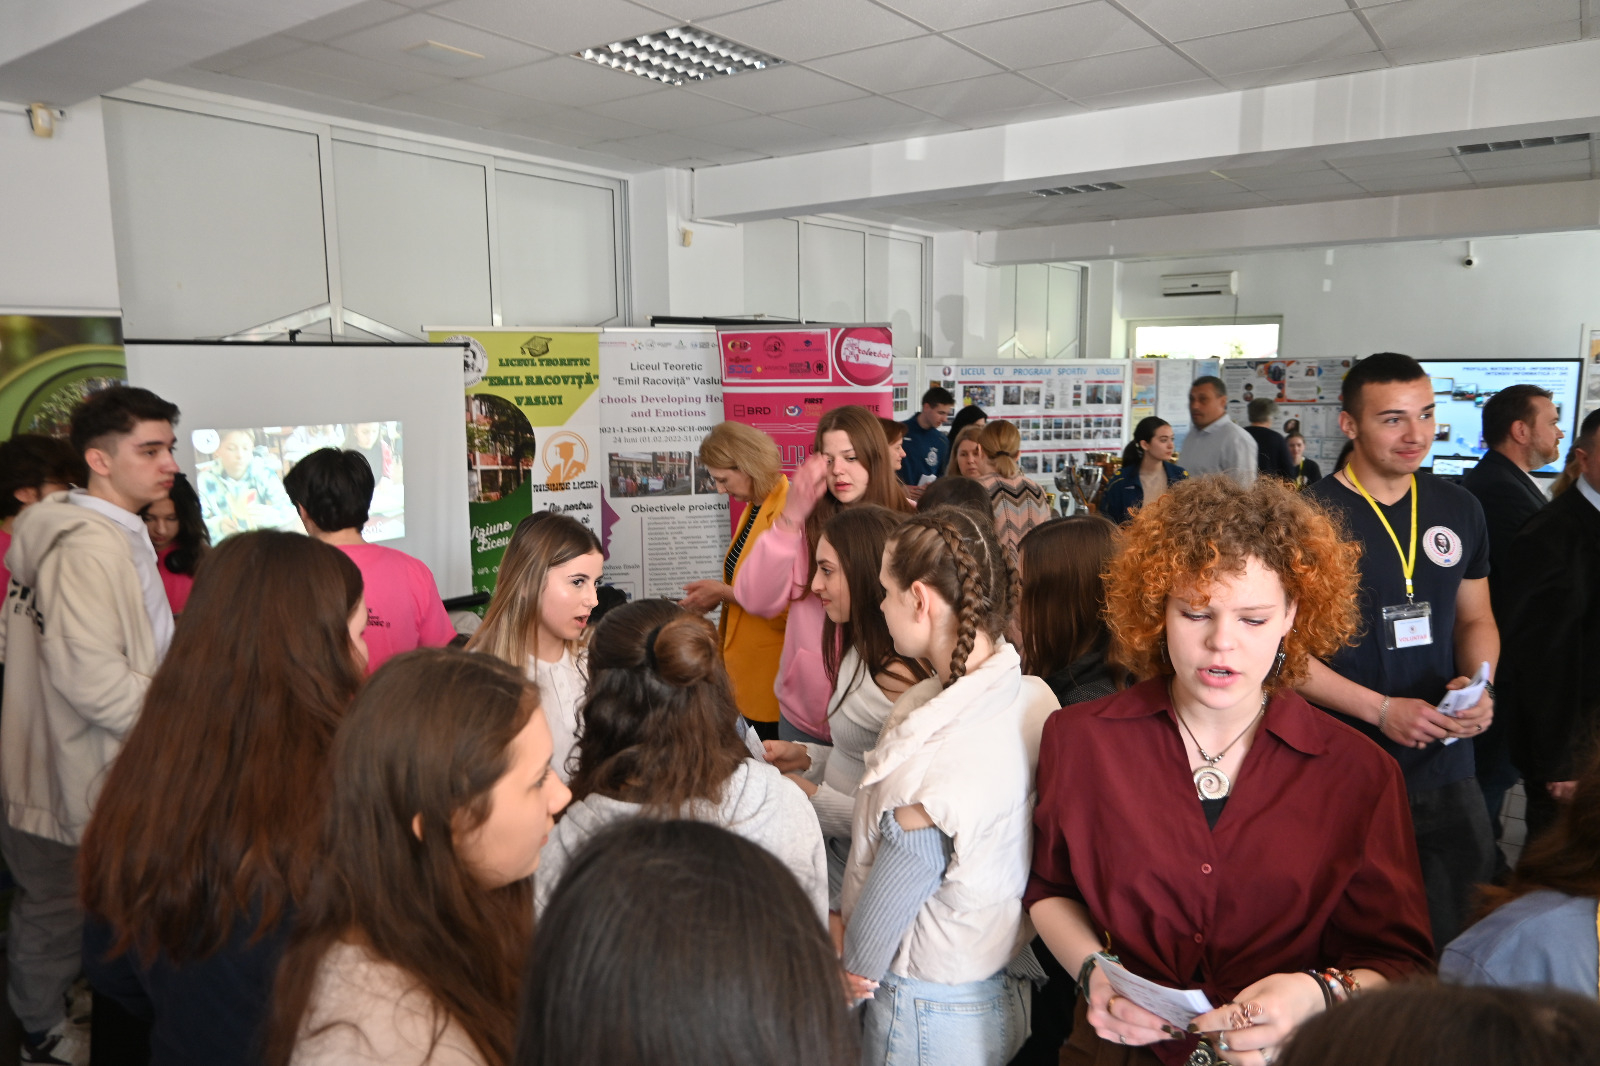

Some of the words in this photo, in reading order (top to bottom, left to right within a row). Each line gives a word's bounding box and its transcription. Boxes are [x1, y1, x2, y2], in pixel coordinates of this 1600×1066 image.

[498, 358, 537, 367] LICEUL
[538, 358, 590, 367] TEORETIC
[630, 362, 660, 371] Liceul
[663, 362, 703, 371] Teoretic
[960, 367, 986, 376] LICEUL
[993, 367, 1005, 376] CU
[1013, 367, 1051, 376] PROGRAM
[1057, 367, 1088, 376] SPORTIV
[1096, 367, 1120, 376] VASLUI
[612, 376, 640, 386] "Emil
[693, 375, 723, 386] Vaslui
[514, 395, 563, 406] VASLUI
[599, 395, 637, 404] chools
[641, 394, 702, 407] Developing
[630, 408, 651, 418] and
[655, 408, 706, 418] Emotions
[747, 406, 771, 415] BRD
[631, 503, 686, 513] Obiectivele
